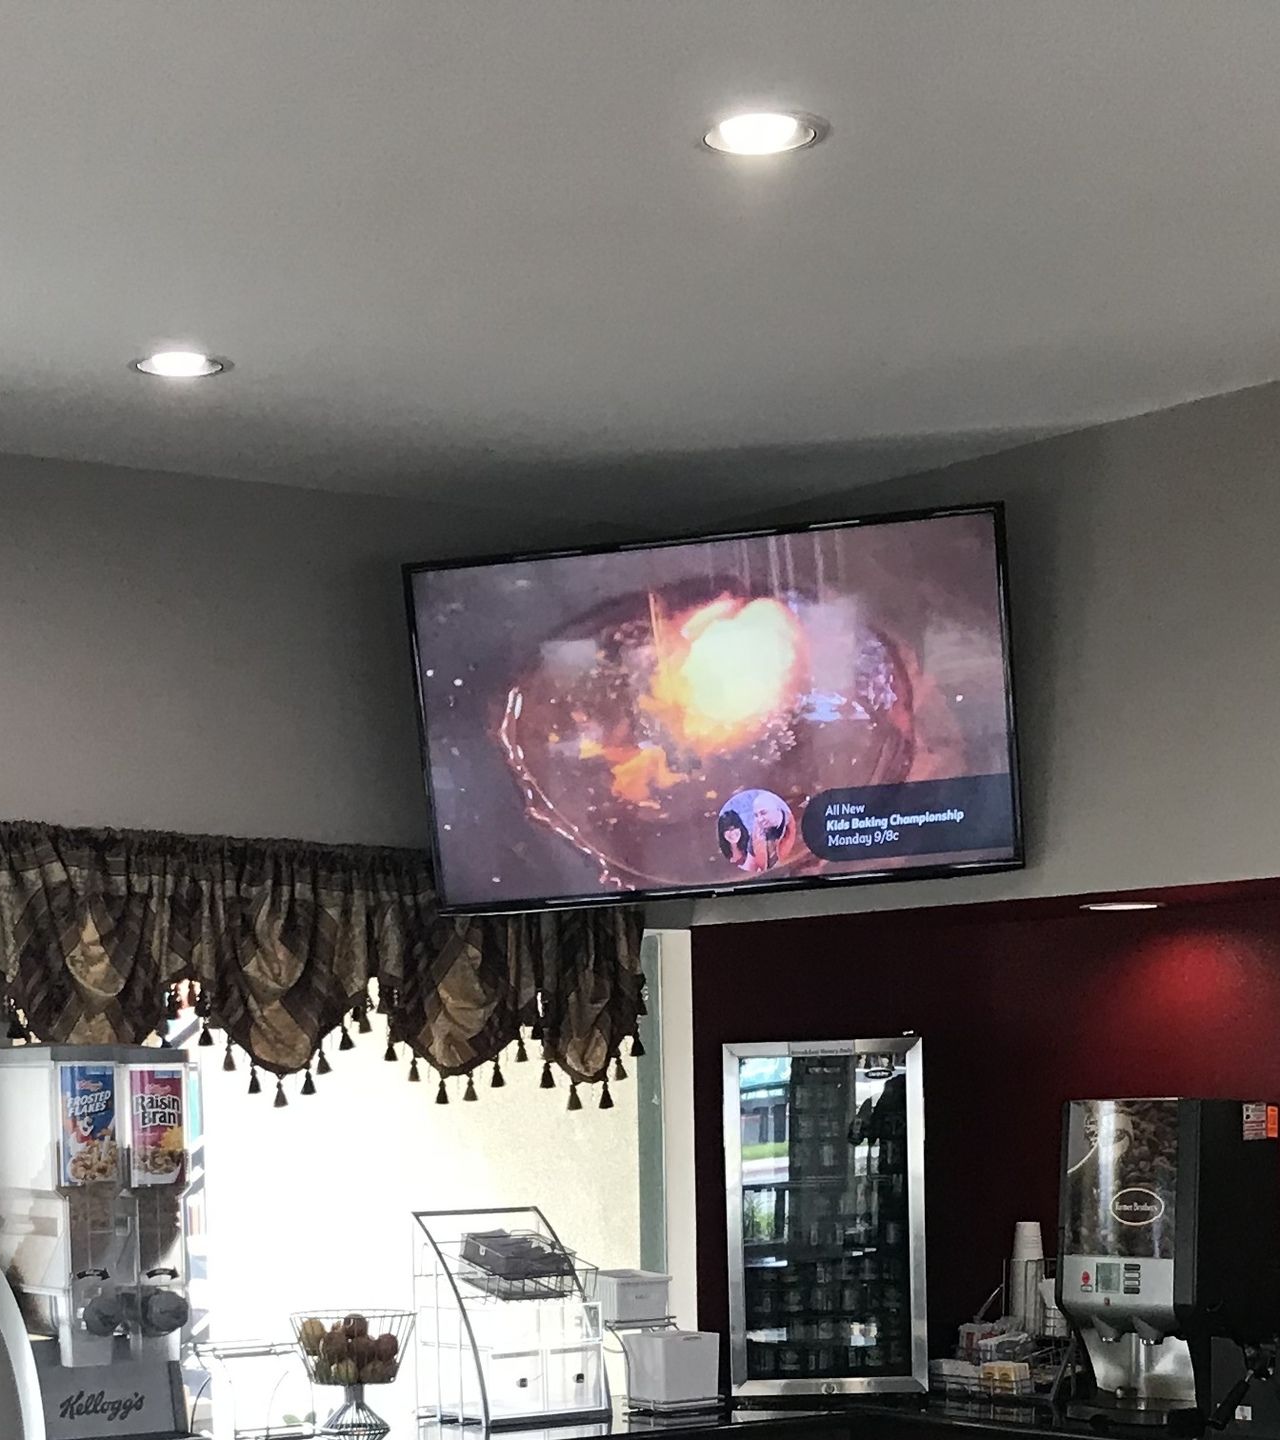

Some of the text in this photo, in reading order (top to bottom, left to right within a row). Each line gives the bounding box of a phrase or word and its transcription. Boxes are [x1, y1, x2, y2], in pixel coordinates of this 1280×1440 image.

[825, 803, 866, 817] All New
[826, 808, 965, 832] Kids Baking Championship
[827, 829, 900, 847] Monday 9/8c
[66, 1089, 111, 1108] FROSTED
[135, 1093, 181, 1115] Raisin
[68, 1101, 107, 1117] FLAKES
[141, 1110, 178, 1128] Bran
[59, 1390, 145, 1421] Kellogg's
